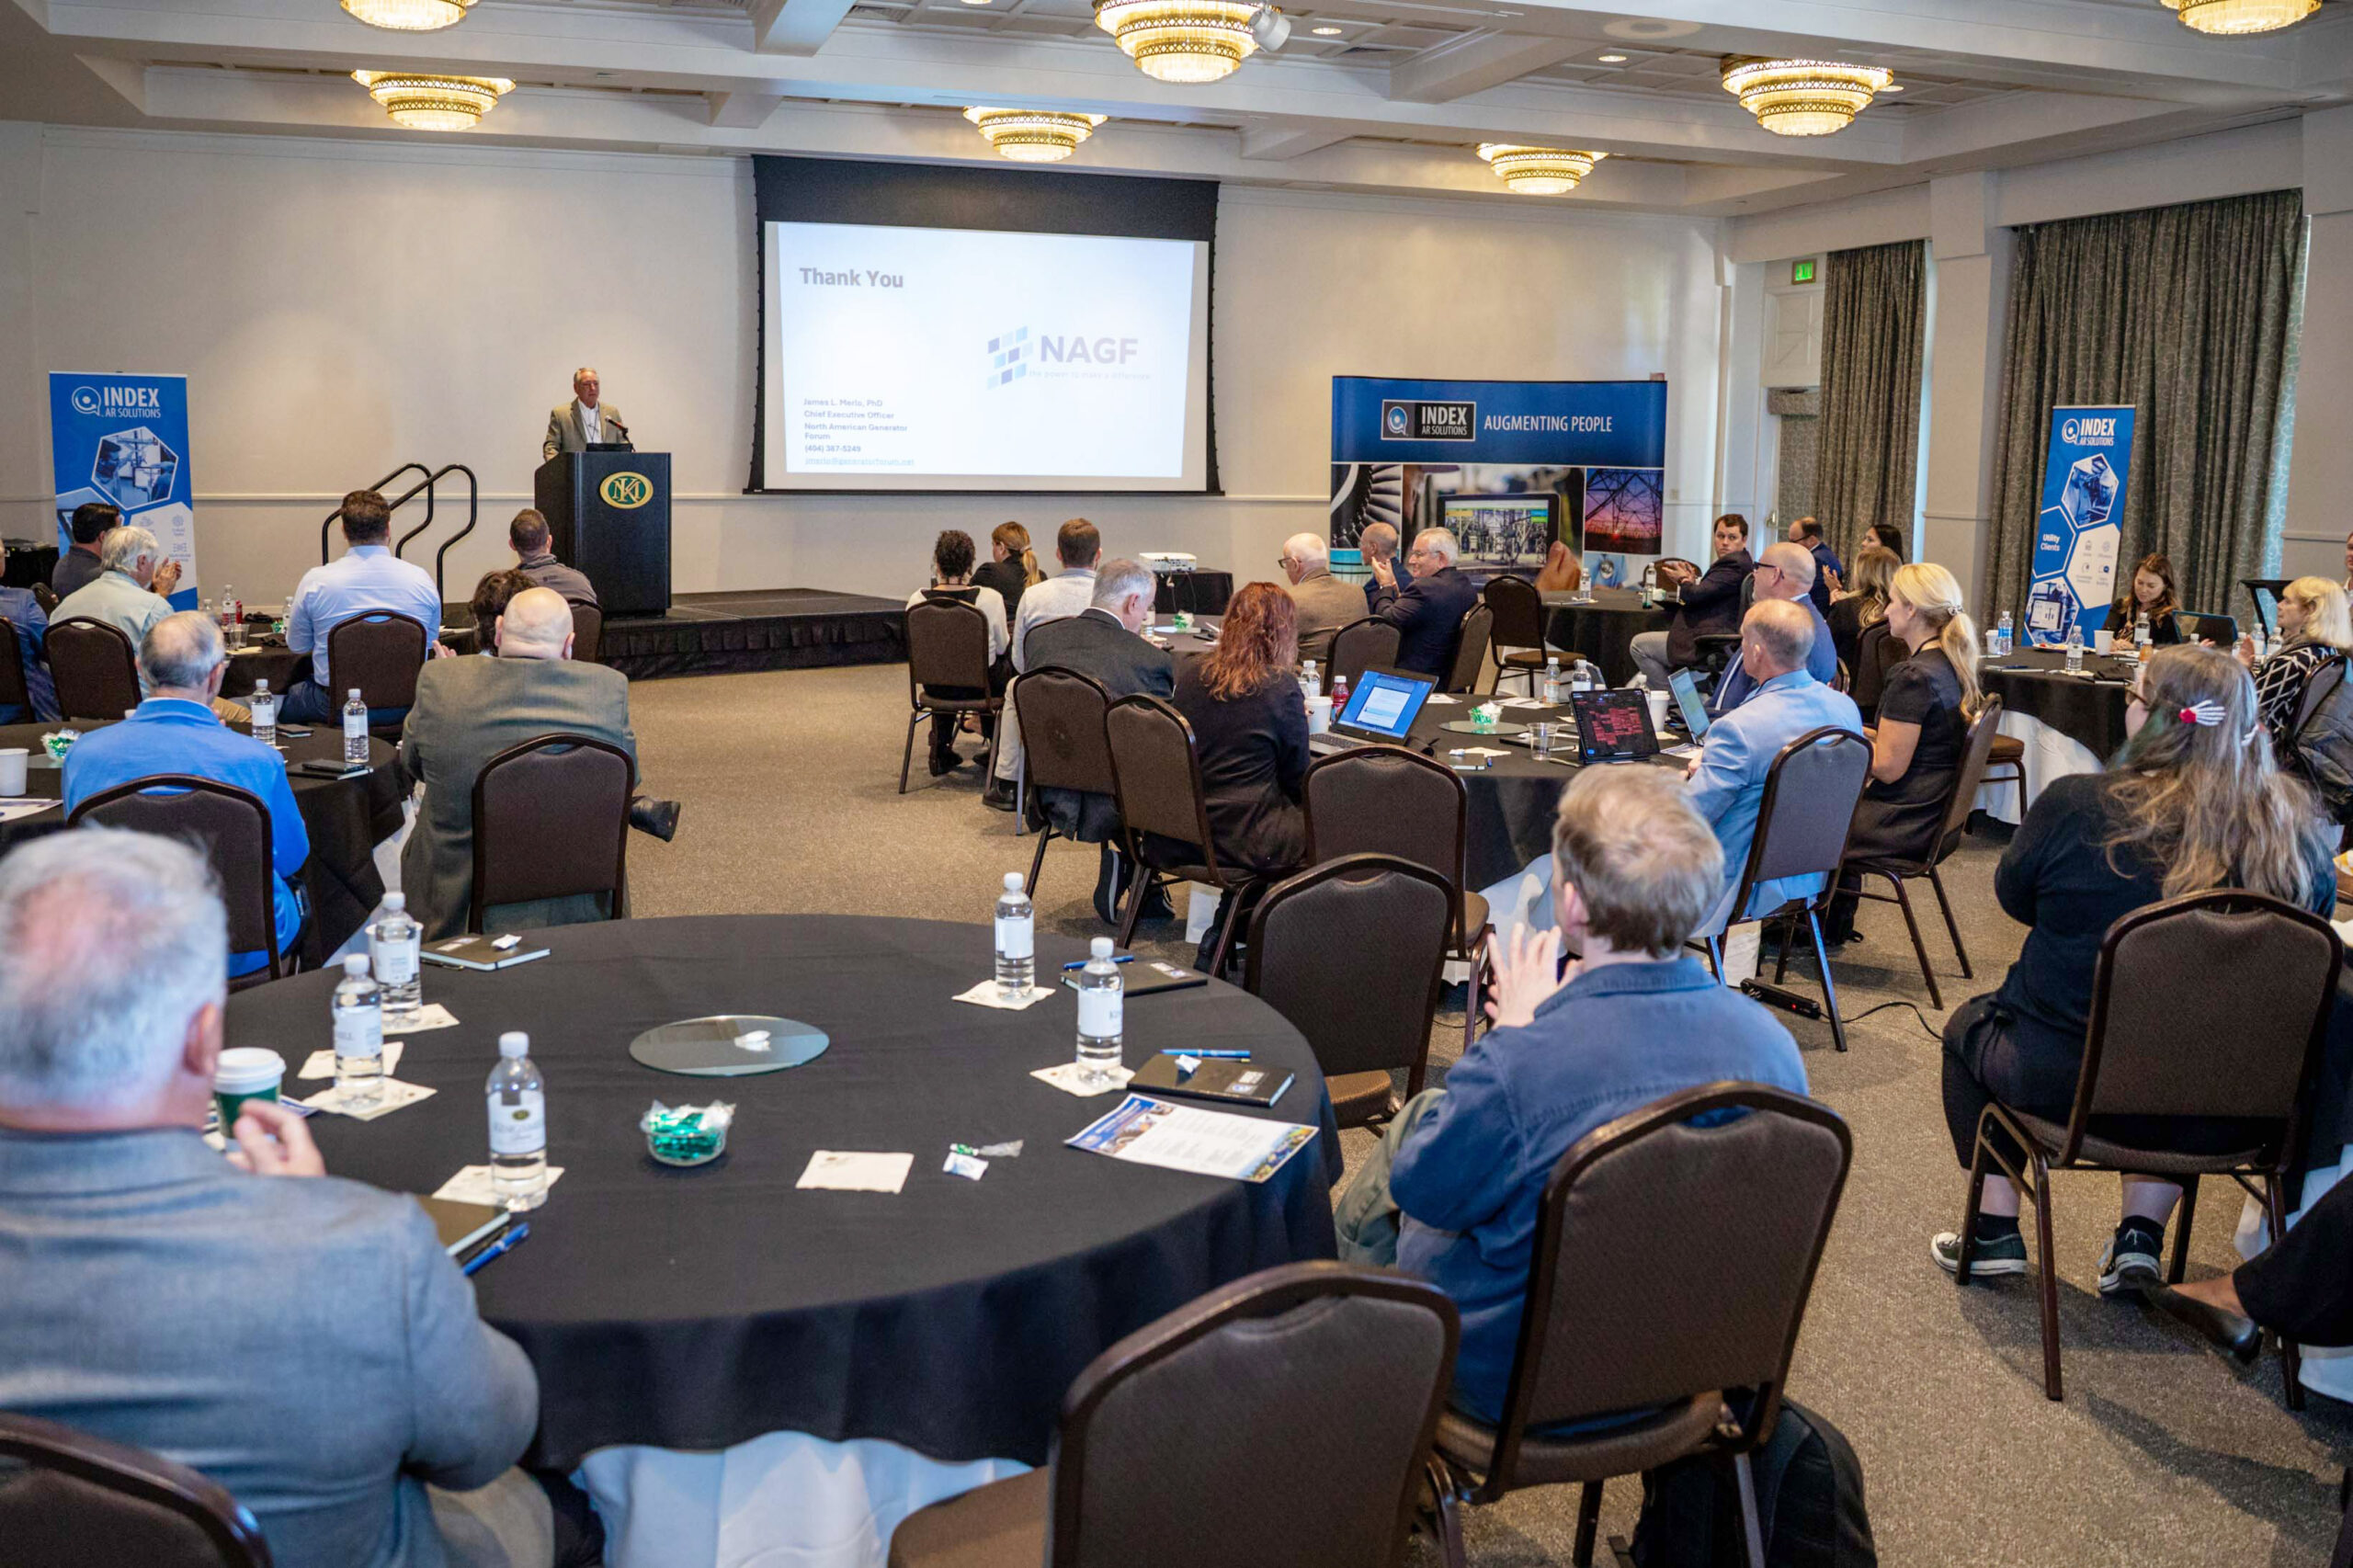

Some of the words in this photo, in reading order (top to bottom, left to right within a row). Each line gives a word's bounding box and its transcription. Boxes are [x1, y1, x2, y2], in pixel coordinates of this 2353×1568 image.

[799, 267, 861, 287] Thank
[866, 269, 904, 289] You
[1040, 335, 1139, 365] NAGF
[104, 386, 160, 407] INDEX
[803, 398, 828, 406] James
[866, 399, 883, 407] PhD
[106, 407, 117, 417] AR
[118, 407, 162, 419] SOLUTIONS
[804, 410, 826, 418] Chief
[827, 410, 866, 419] Executive
[867, 411, 895, 419] Officer
[1421, 405, 1468, 426] INDEX
[804, 422, 827, 431] North
[828, 423, 867, 431] American
[868, 424, 908, 432] Generator
[1483, 415, 1569, 432] AUGMENTING
[1570, 415, 1613, 433] PEOPLE
[2080, 418, 2117, 437] INDEX
[804, 432, 831, 440] Forum
[1421, 426, 1432, 435] AR
[1431, 426, 1468, 436] SOLUTIONS
[2086, 437, 2114, 447] SOLUTIONS
[2042, 533, 2061, 544] Utility
